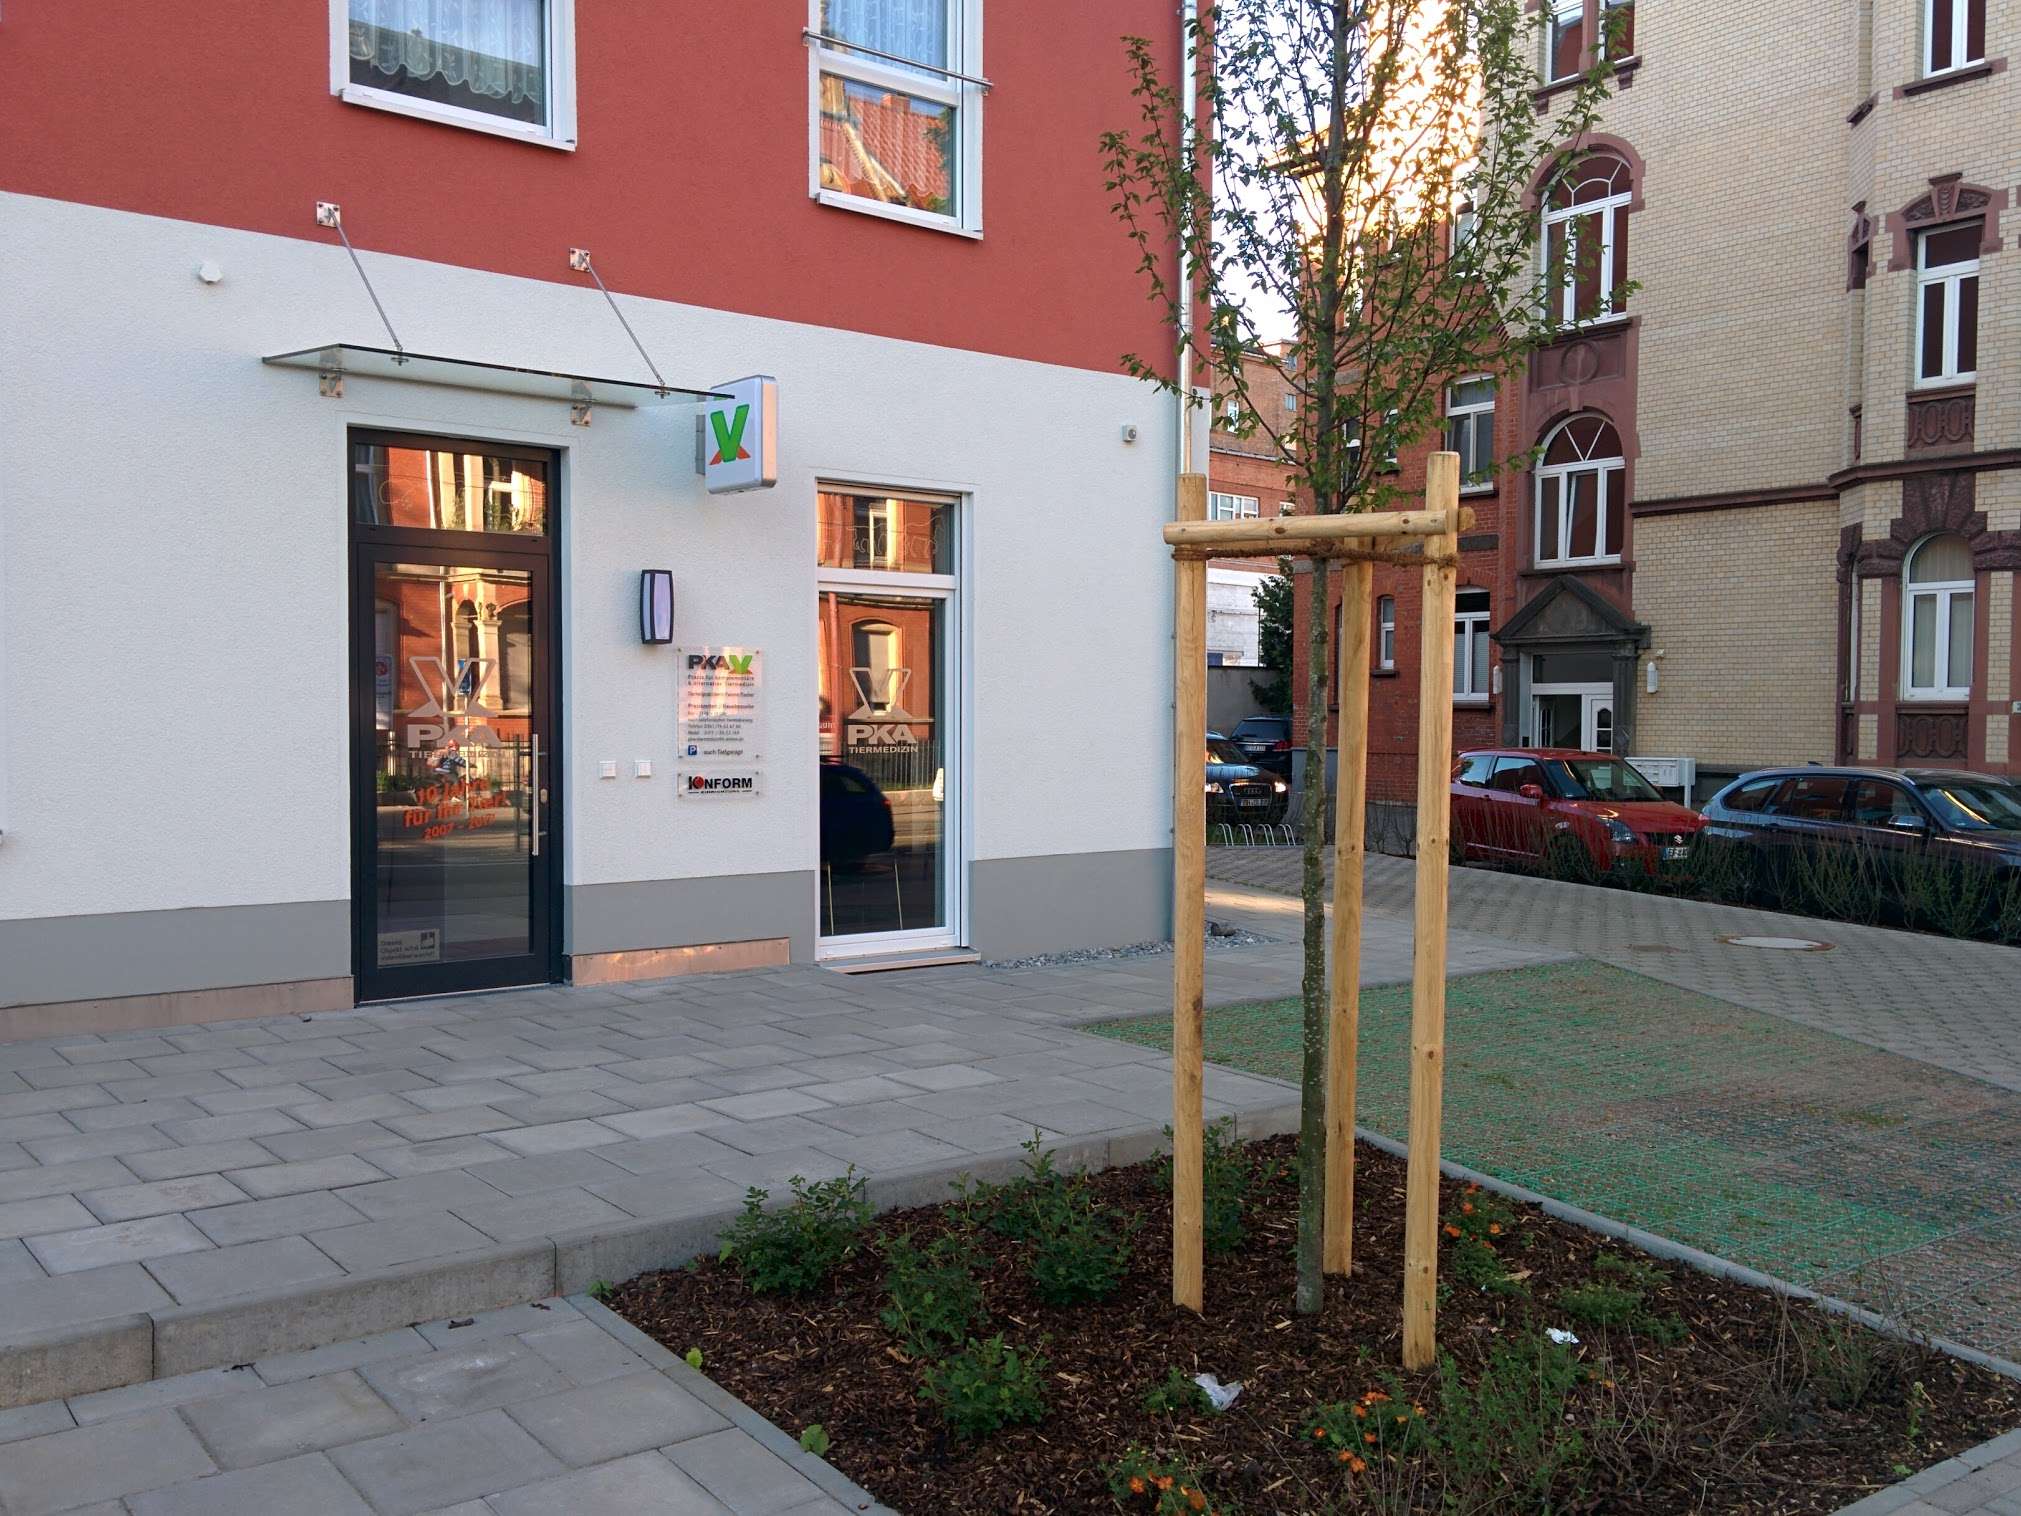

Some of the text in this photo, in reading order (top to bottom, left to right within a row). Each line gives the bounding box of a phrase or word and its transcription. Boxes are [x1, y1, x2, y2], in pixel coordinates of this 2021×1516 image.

[848, 725, 917, 745] PKA
[849, 746, 918, 754] TIERMEDIZIN
[416, 785, 438, 805] 10
[402, 809, 431, 831] für
